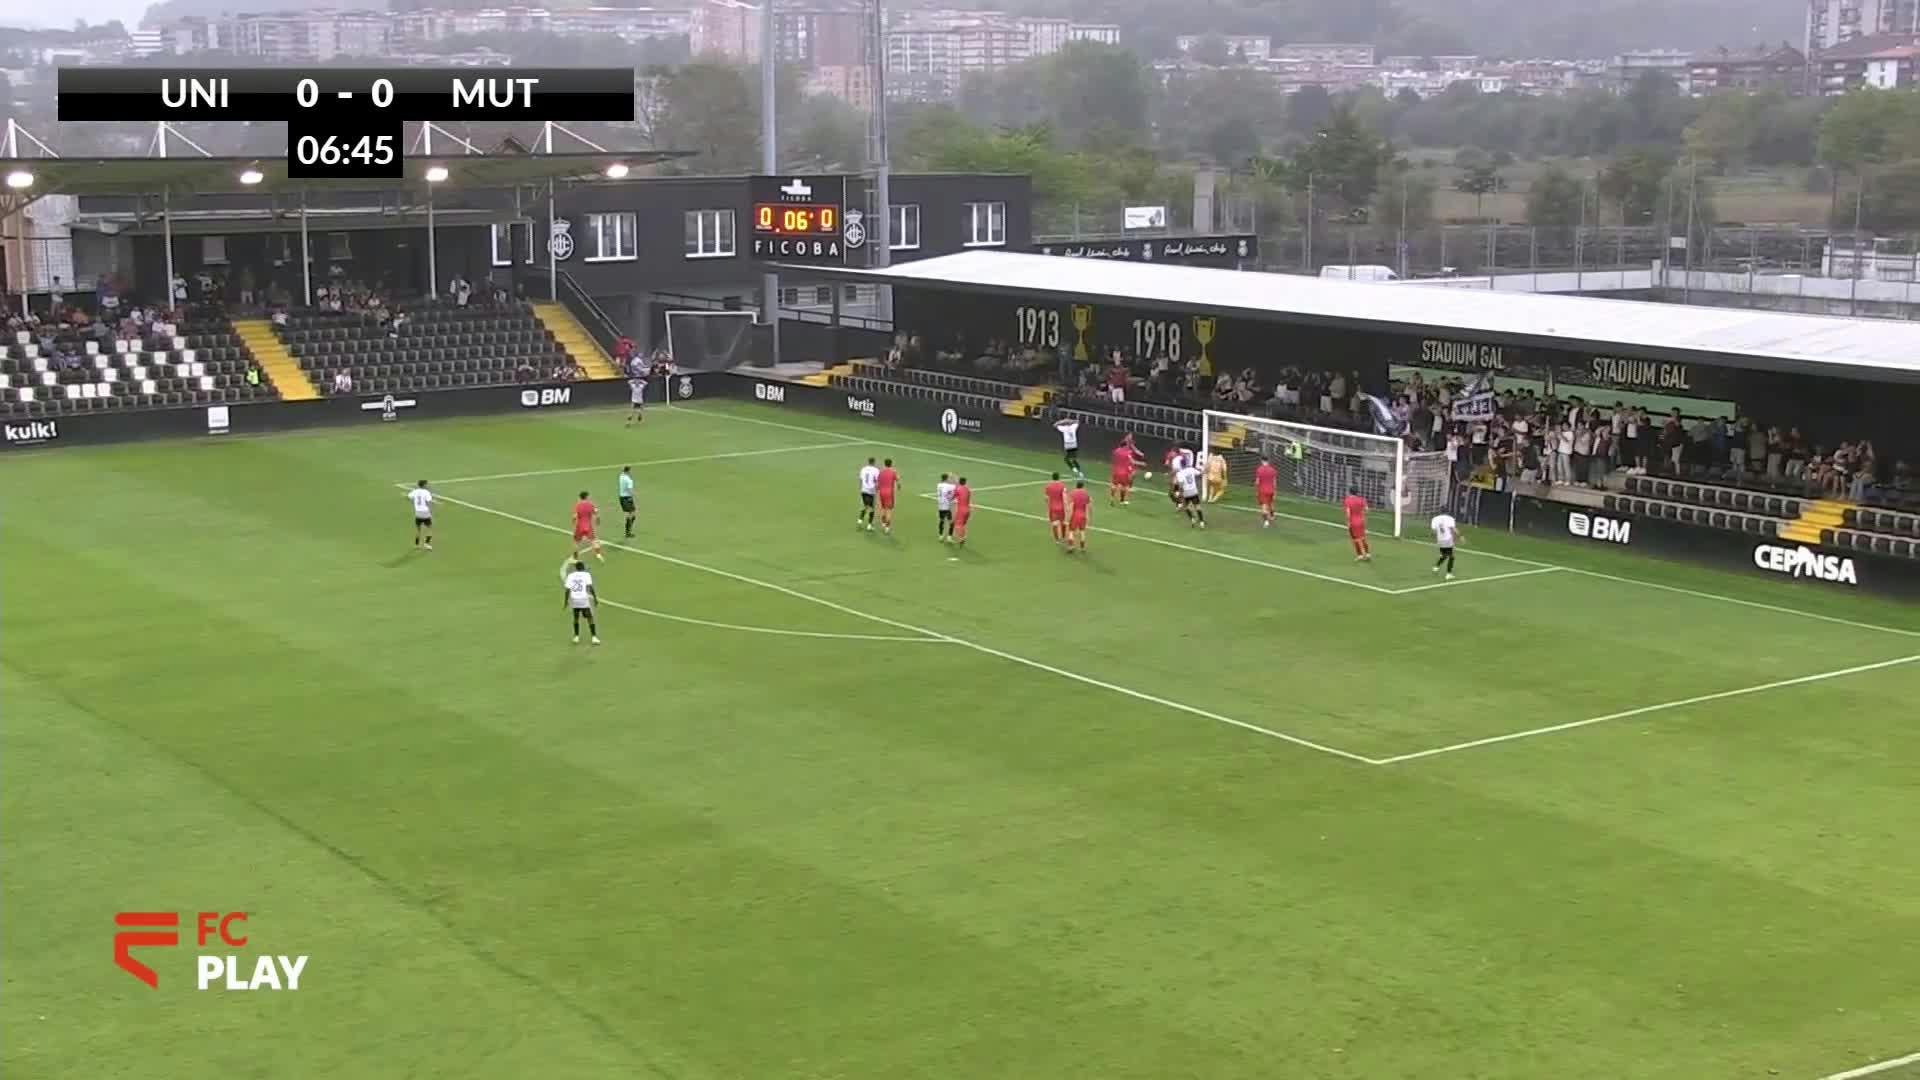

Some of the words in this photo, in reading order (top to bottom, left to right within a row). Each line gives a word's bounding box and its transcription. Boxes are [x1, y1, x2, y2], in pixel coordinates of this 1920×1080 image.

[760, 207, 772, 226] 0
[821, 209, 833, 228] 0
[755, 241, 838, 256] FICOBA
[1016, 306, 1060, 348] 1913
[1133, 319, 1181, 363] 1918
[1422, 340, 1477, 367] STADIUM
[1480, 345, 1504, 369] GAL
[1592, 357, 1656, 387] STADIUM
[1659, 364, 1690, 390] GAL
[541, 387, 571, 406] BM
[766, 385, 784, 402] BM
[848, 396, 874, 412] Vertiz
[5, 421, 57, 441] kuik!
[1592, 517, 1631, 544] BM
